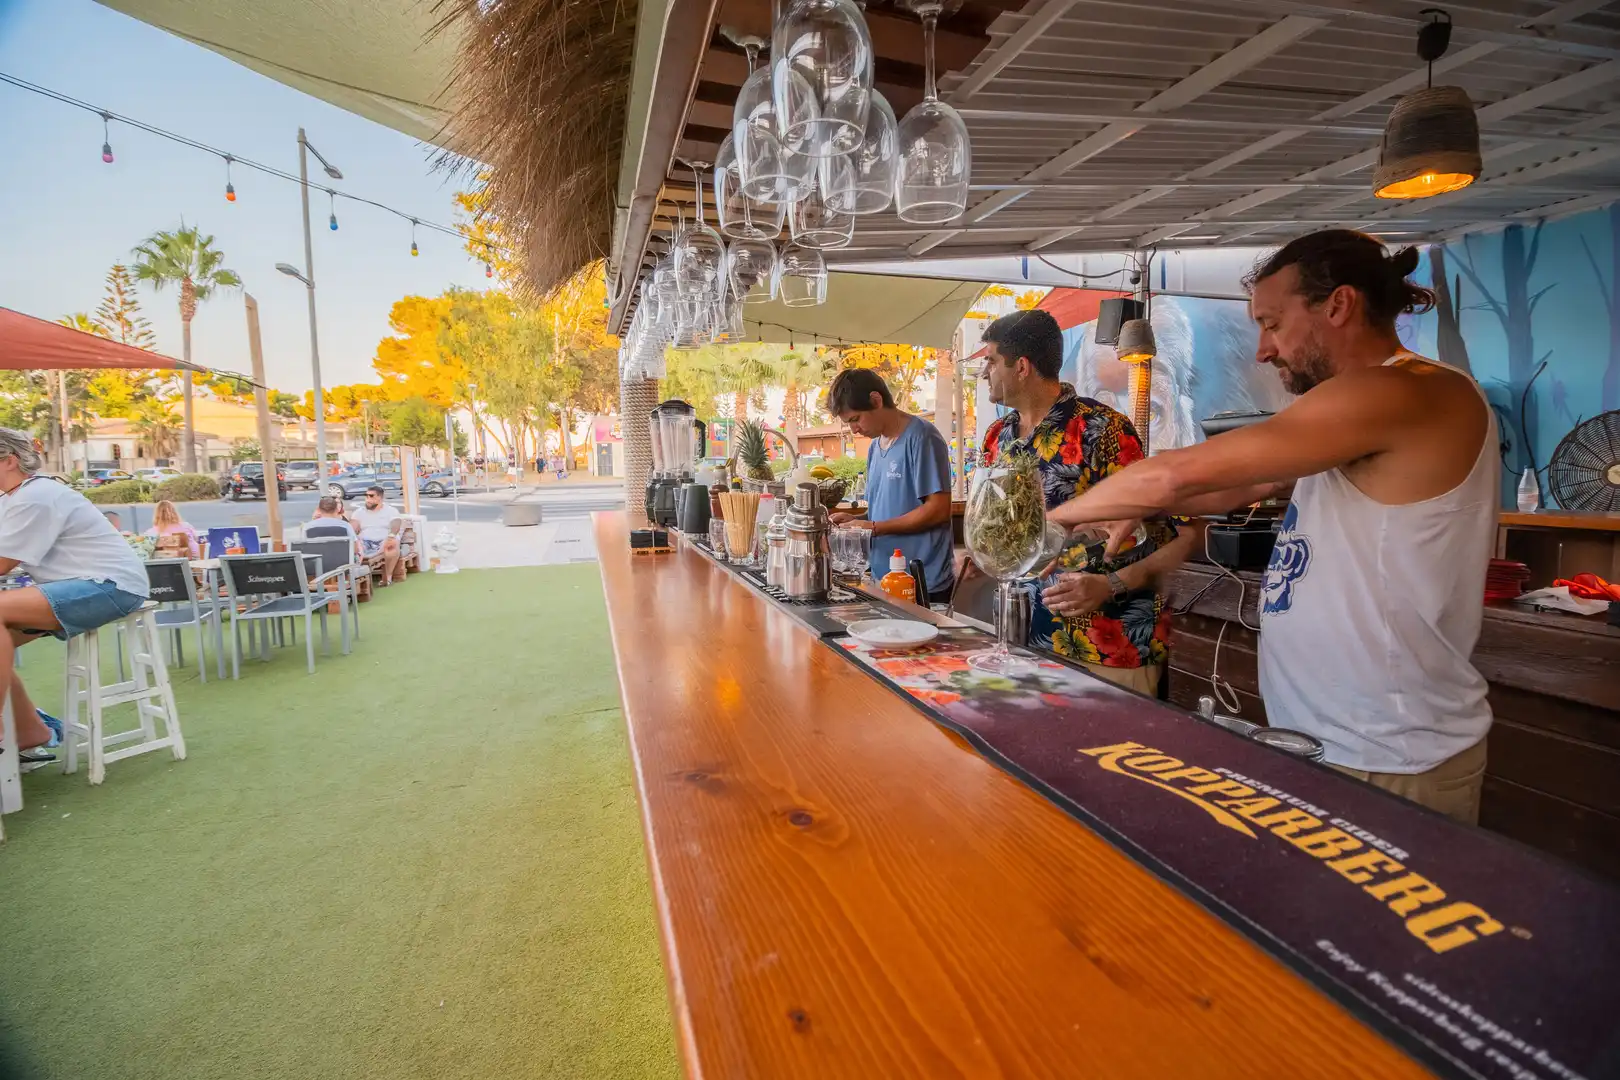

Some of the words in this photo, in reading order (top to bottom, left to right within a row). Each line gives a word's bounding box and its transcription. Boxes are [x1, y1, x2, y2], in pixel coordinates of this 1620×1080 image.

[1077, 741, 1505, 954] KOPPARBERG
[1212, 767, 1330, 817] PREMIUM
[1329, 817, 1410, 860] CIDER
[1315, 938, 1367, 973] Enjoy
[1365, 971, 1485, 1051] Kopparberg
